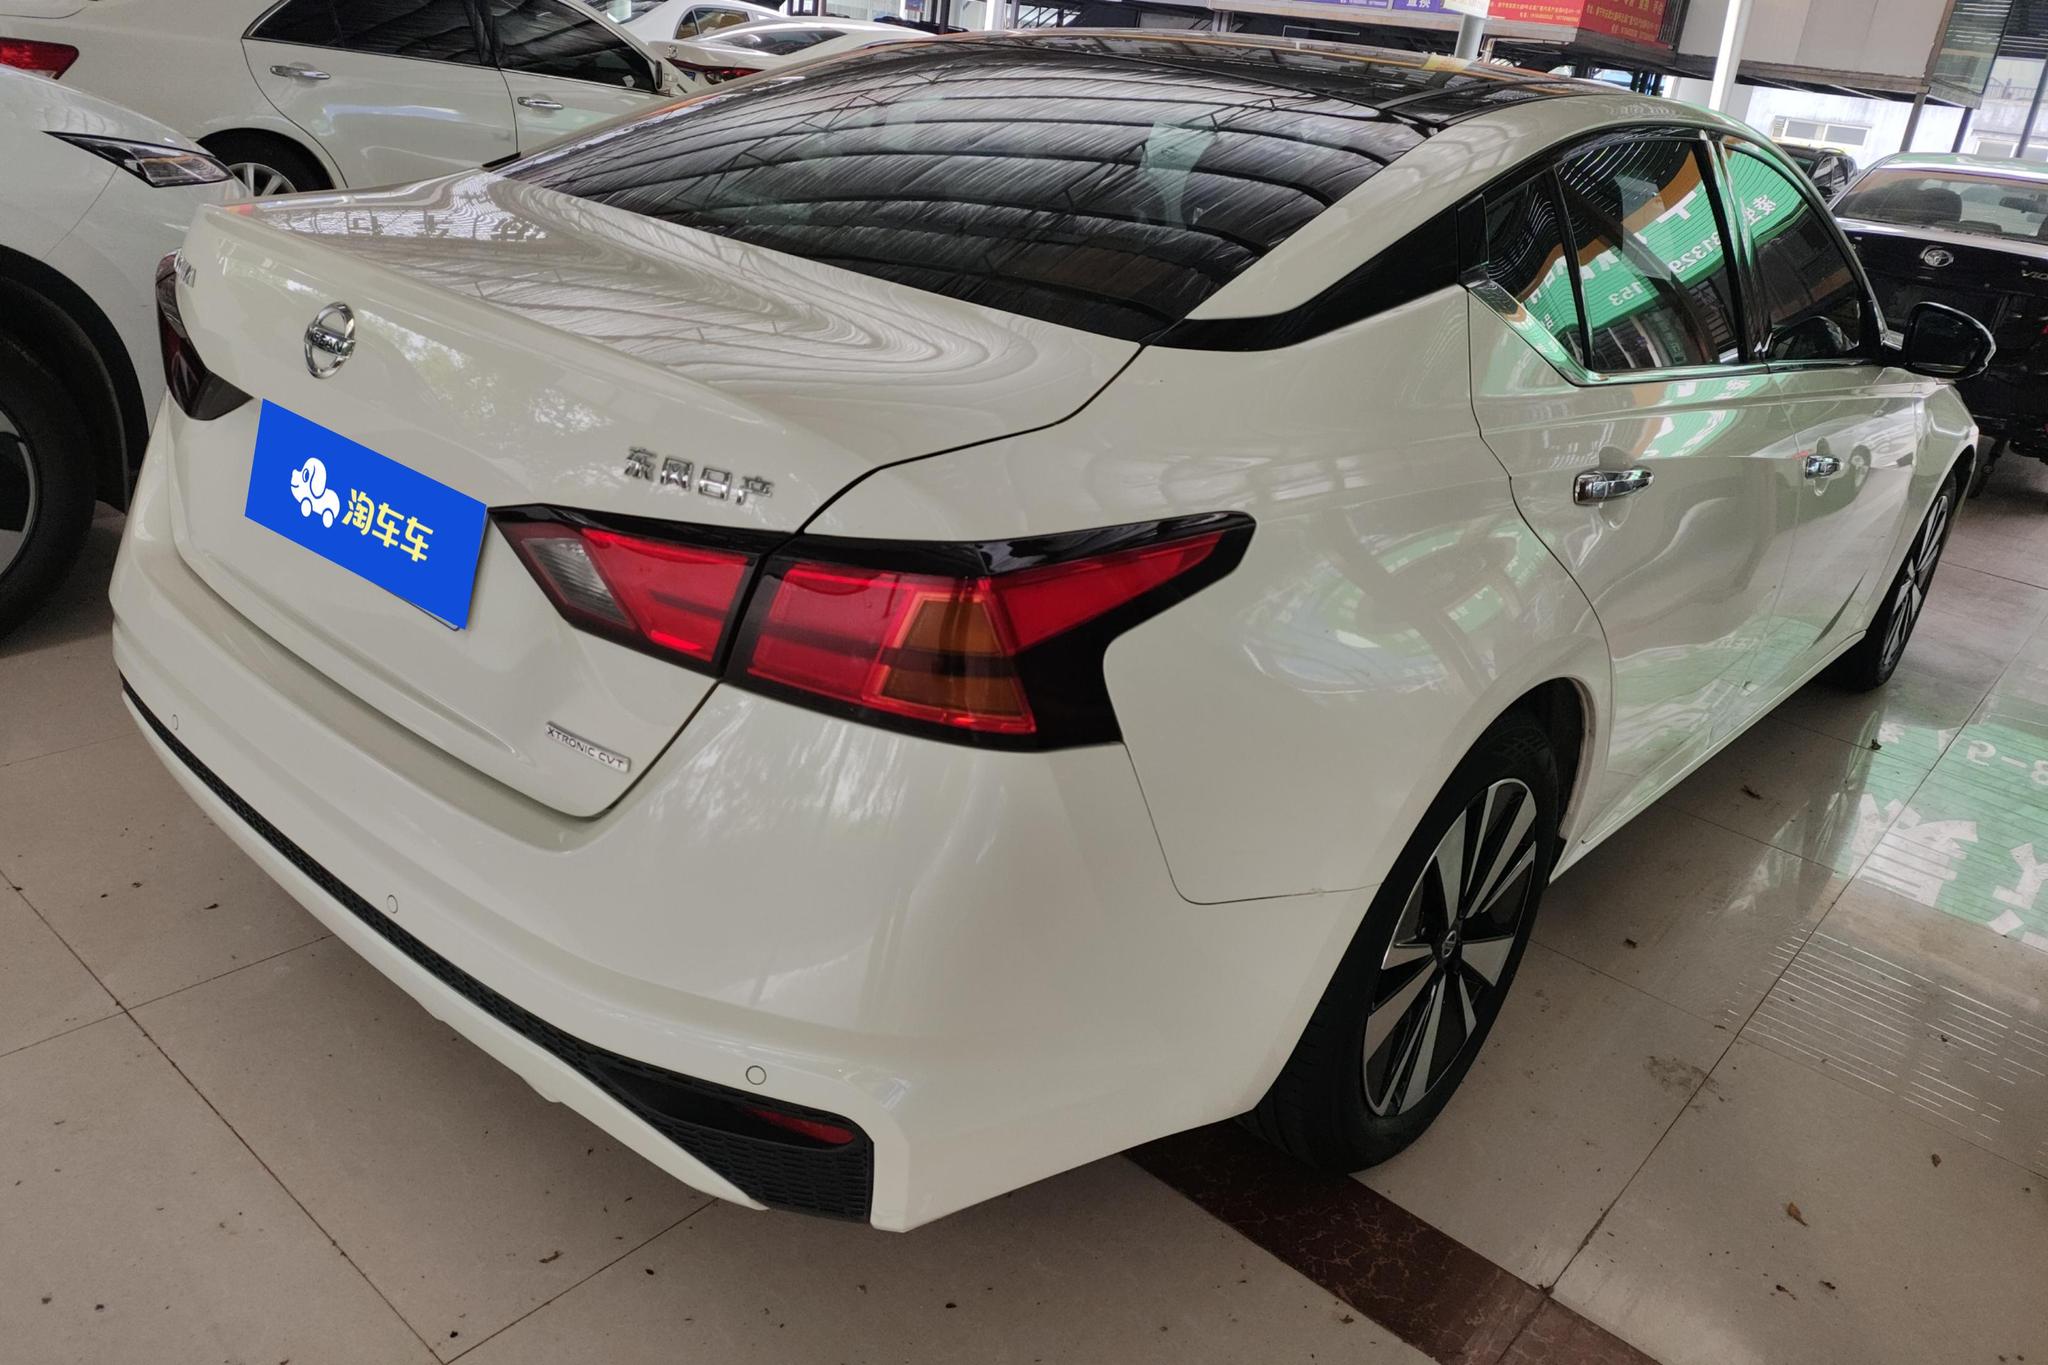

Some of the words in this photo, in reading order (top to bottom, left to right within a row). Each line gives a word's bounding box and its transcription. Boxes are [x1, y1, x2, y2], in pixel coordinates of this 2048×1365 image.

[624, 446, 774, 505] 东风日产
[547, 726, 595, 757] XTRONIC
[598, 752, 624, 768] CVT
